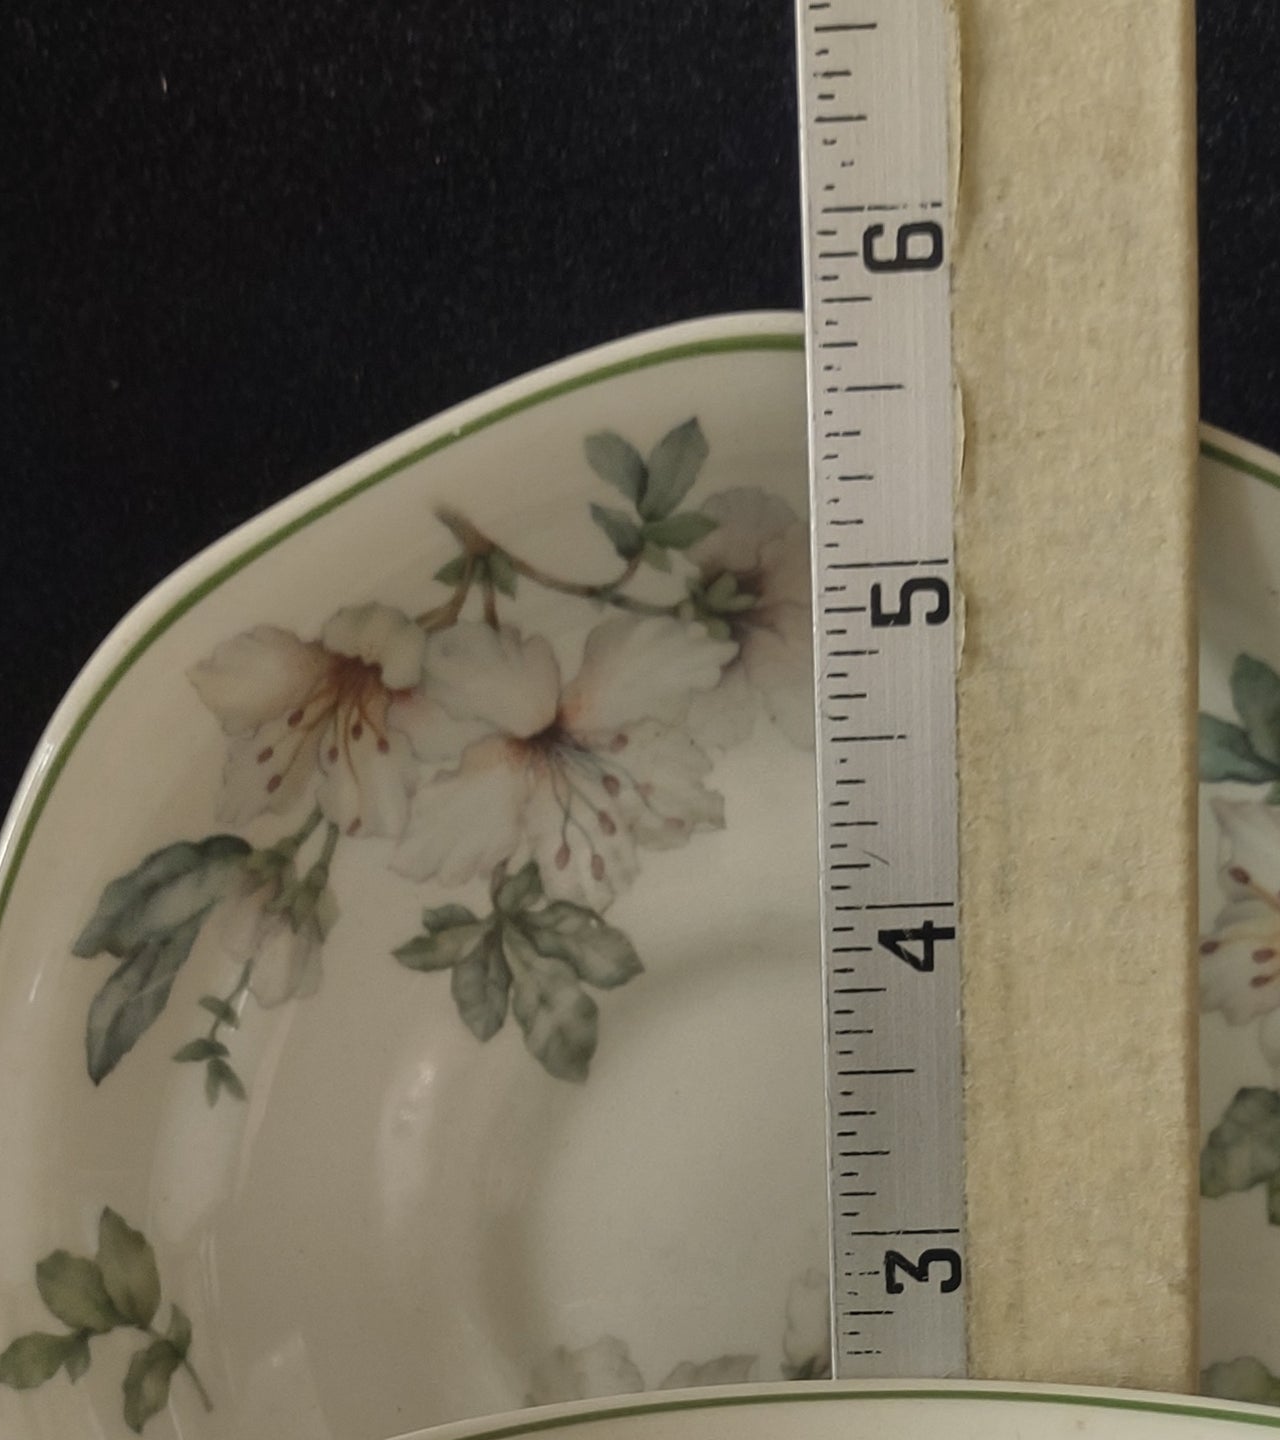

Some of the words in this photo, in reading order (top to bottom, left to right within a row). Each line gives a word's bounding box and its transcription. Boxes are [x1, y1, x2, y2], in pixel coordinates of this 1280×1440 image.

[863, 221, 943, 272] 6
[870, 577, 950, 627] 5
[877, 920, 956, 973] 4
[883, 1248, 963, 1295] 3
